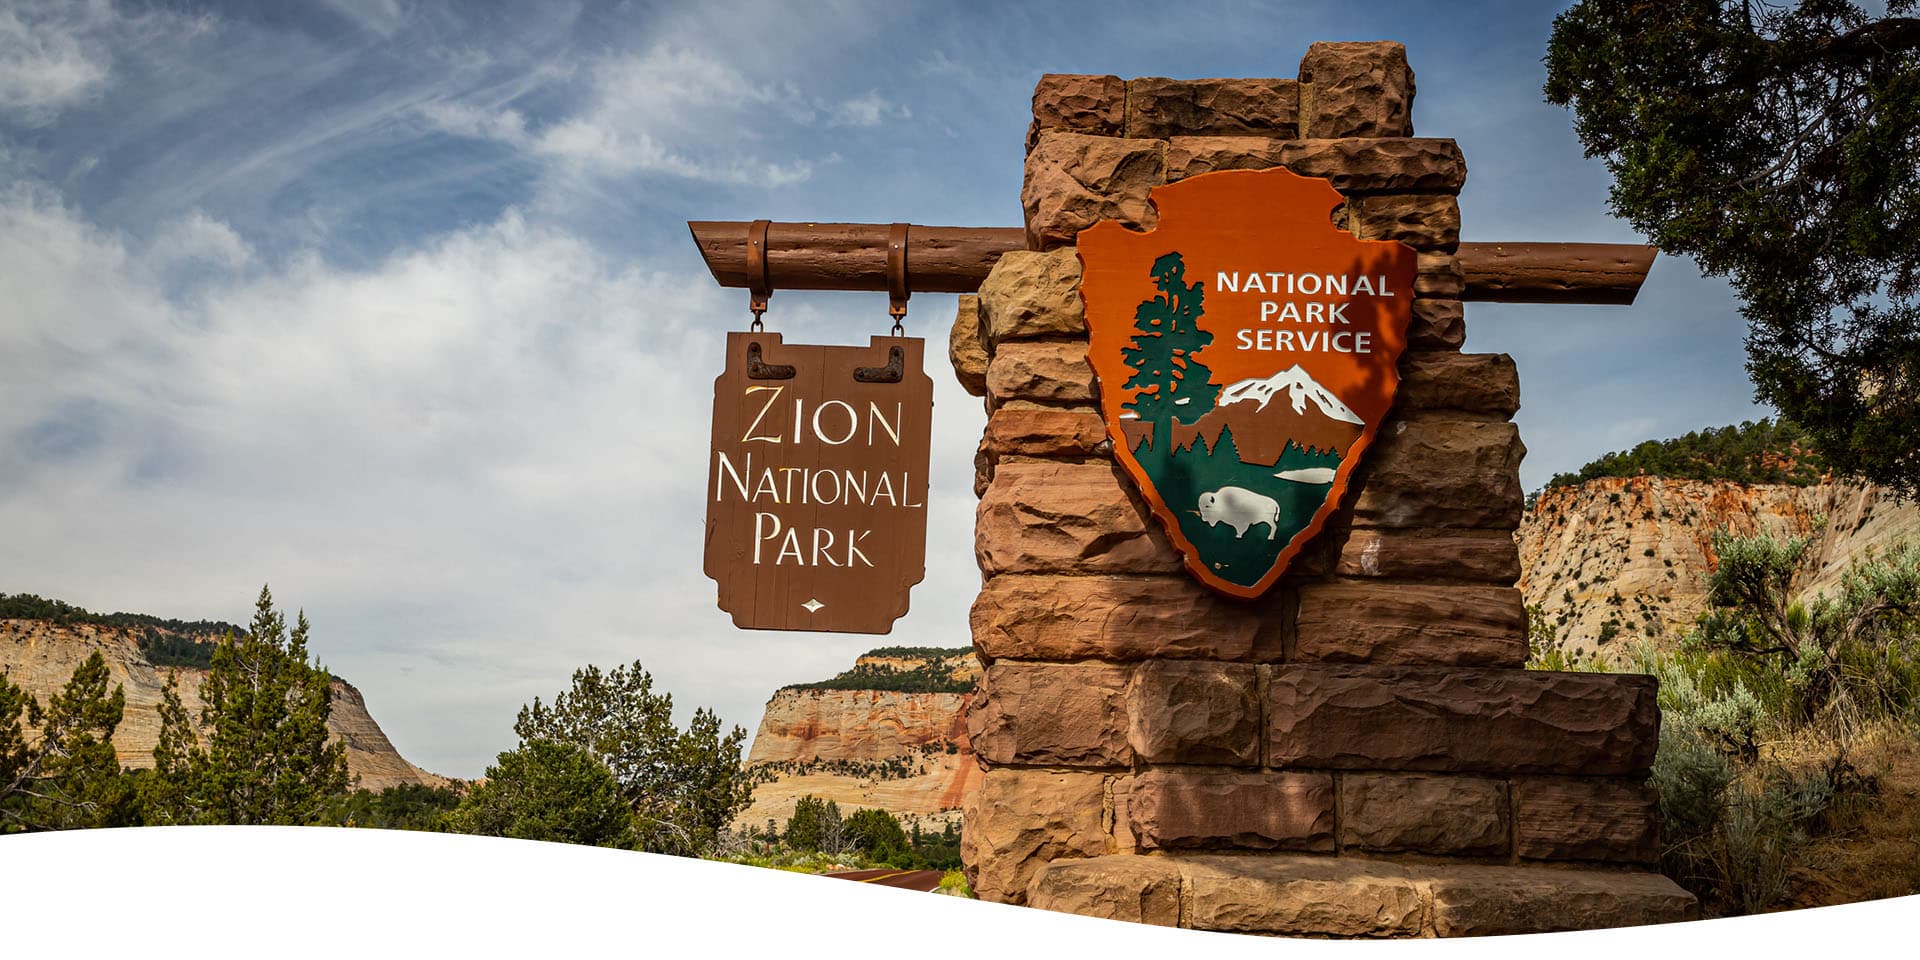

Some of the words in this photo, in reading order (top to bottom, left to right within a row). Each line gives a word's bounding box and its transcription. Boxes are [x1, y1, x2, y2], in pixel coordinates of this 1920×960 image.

[1216, 271, 1395, 297] NATIONAL
[1259, 301, 1351, 325] PARK
[1236, 328, 1372, 354] SERVICE
[741, 385, 902, 447] ZION
[716, 451, 922, 508] NATIONAL
[753, 512, 875, 568] PARK
